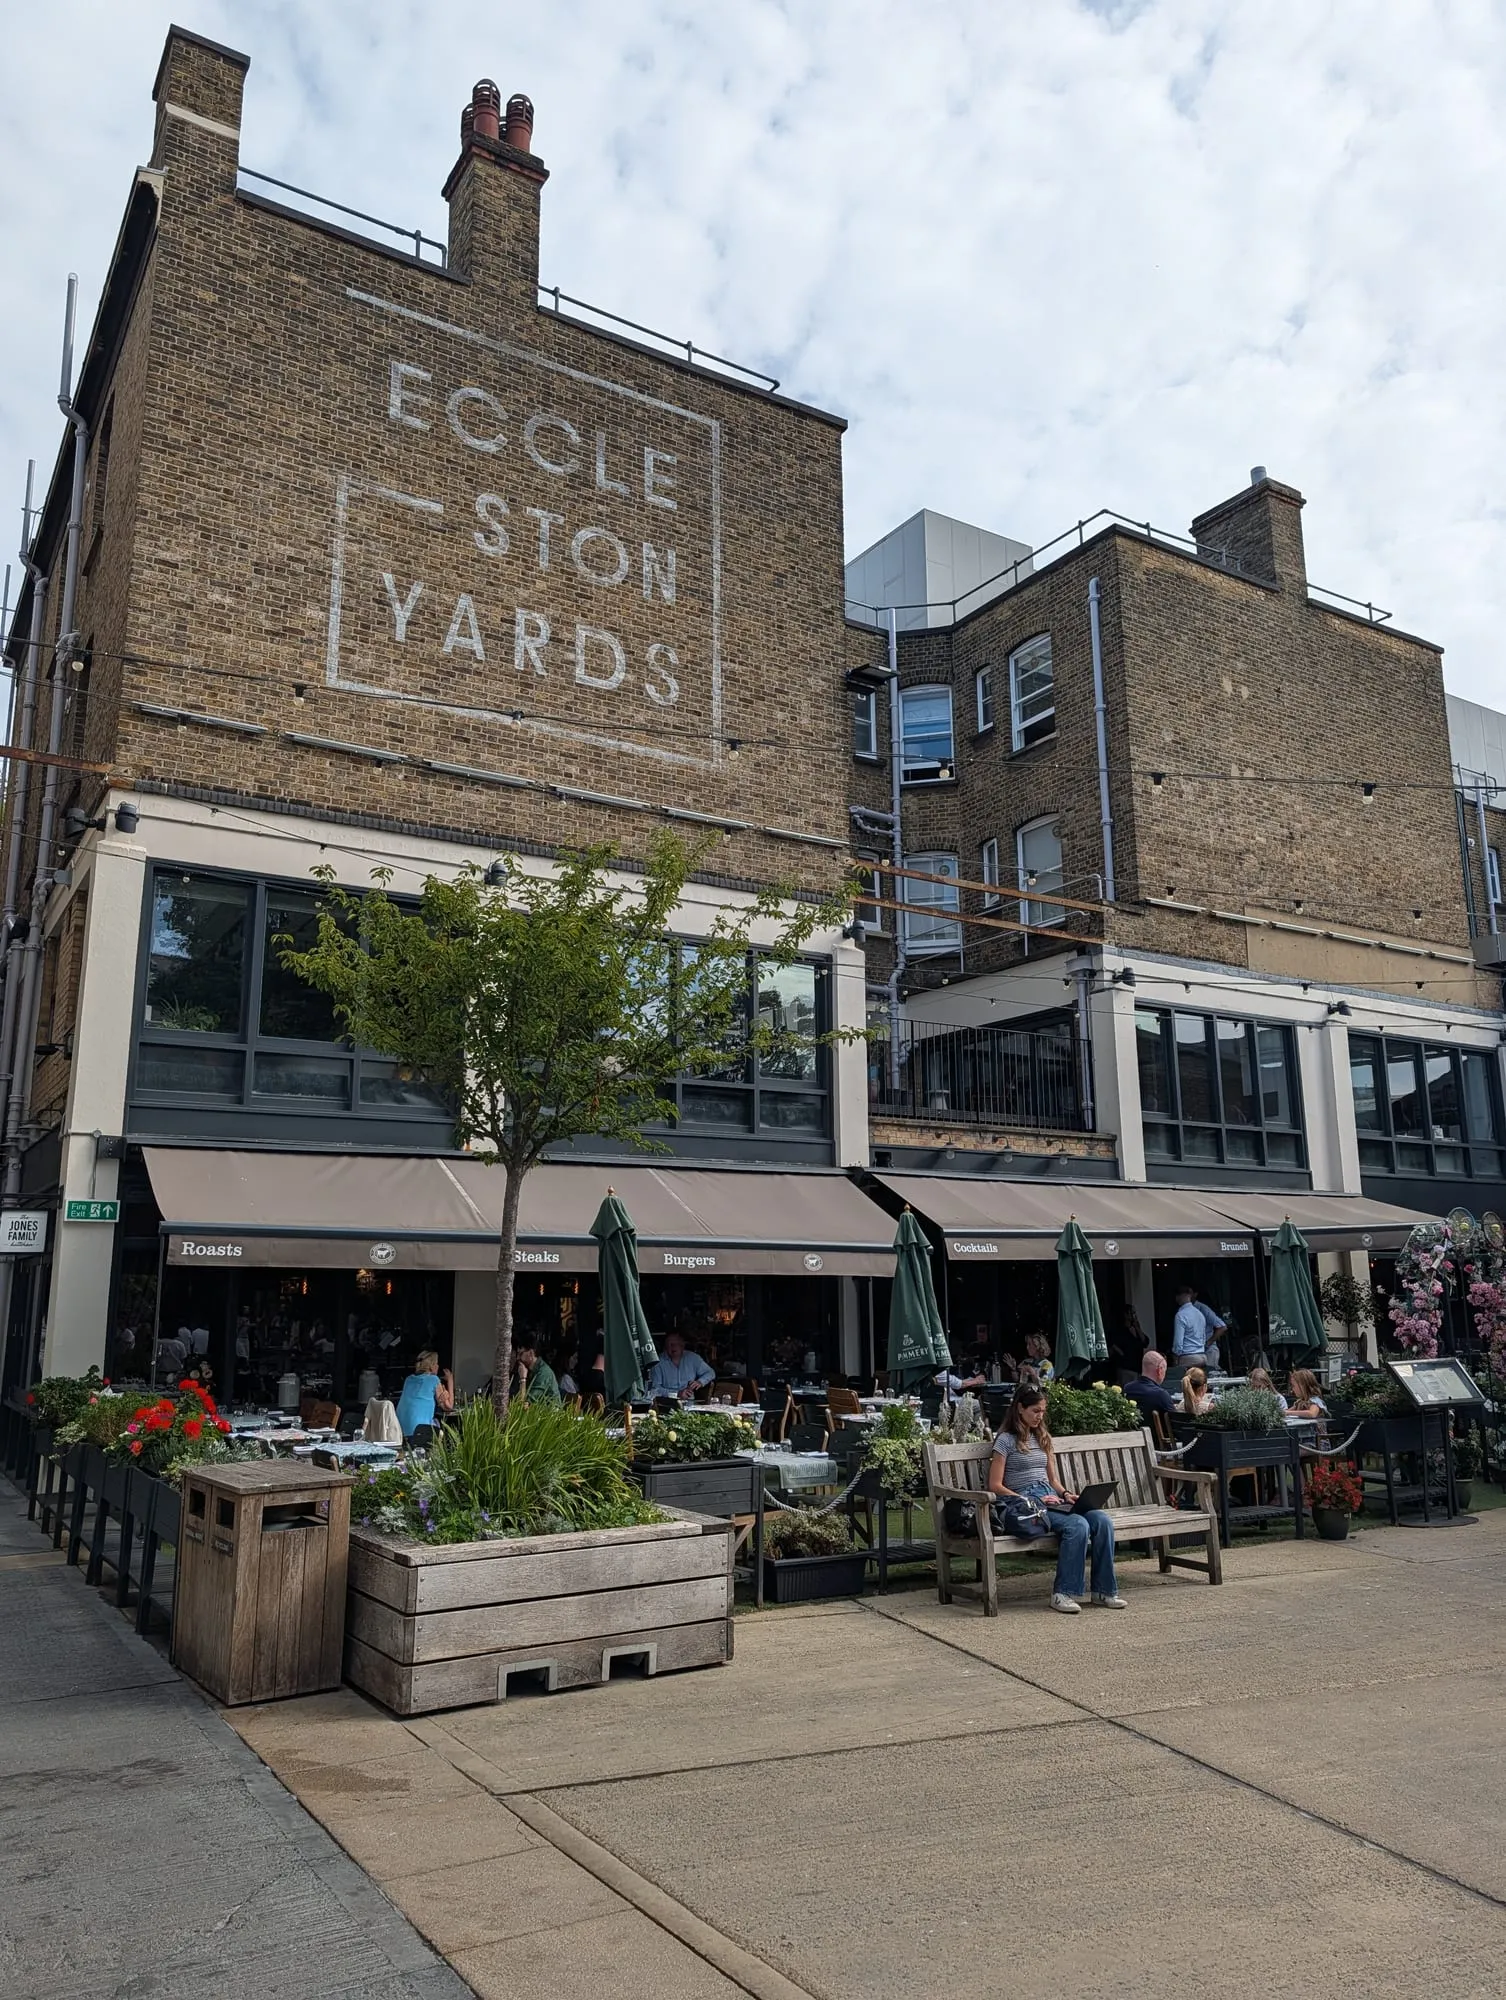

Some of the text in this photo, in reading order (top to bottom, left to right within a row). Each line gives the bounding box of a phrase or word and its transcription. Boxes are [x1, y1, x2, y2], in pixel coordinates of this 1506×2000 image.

[389, 360, 679, 511] ECCLE
[473, 491, 677, 602] STON
[382, 572, 680, 707] YARDS
[9, 1220, 39, 1231] JONES
[7, 1231, 38, 1241] FAMILY
[181, 1241, 243, 1257] Roasts
[953, 1242, 999, 1253] Cocktails
[1220, 1241, 1249, 1251] Brunch
[514, 1250, 560, 1263] Steaks
[663, 1253, 716, 1269] Burgers
